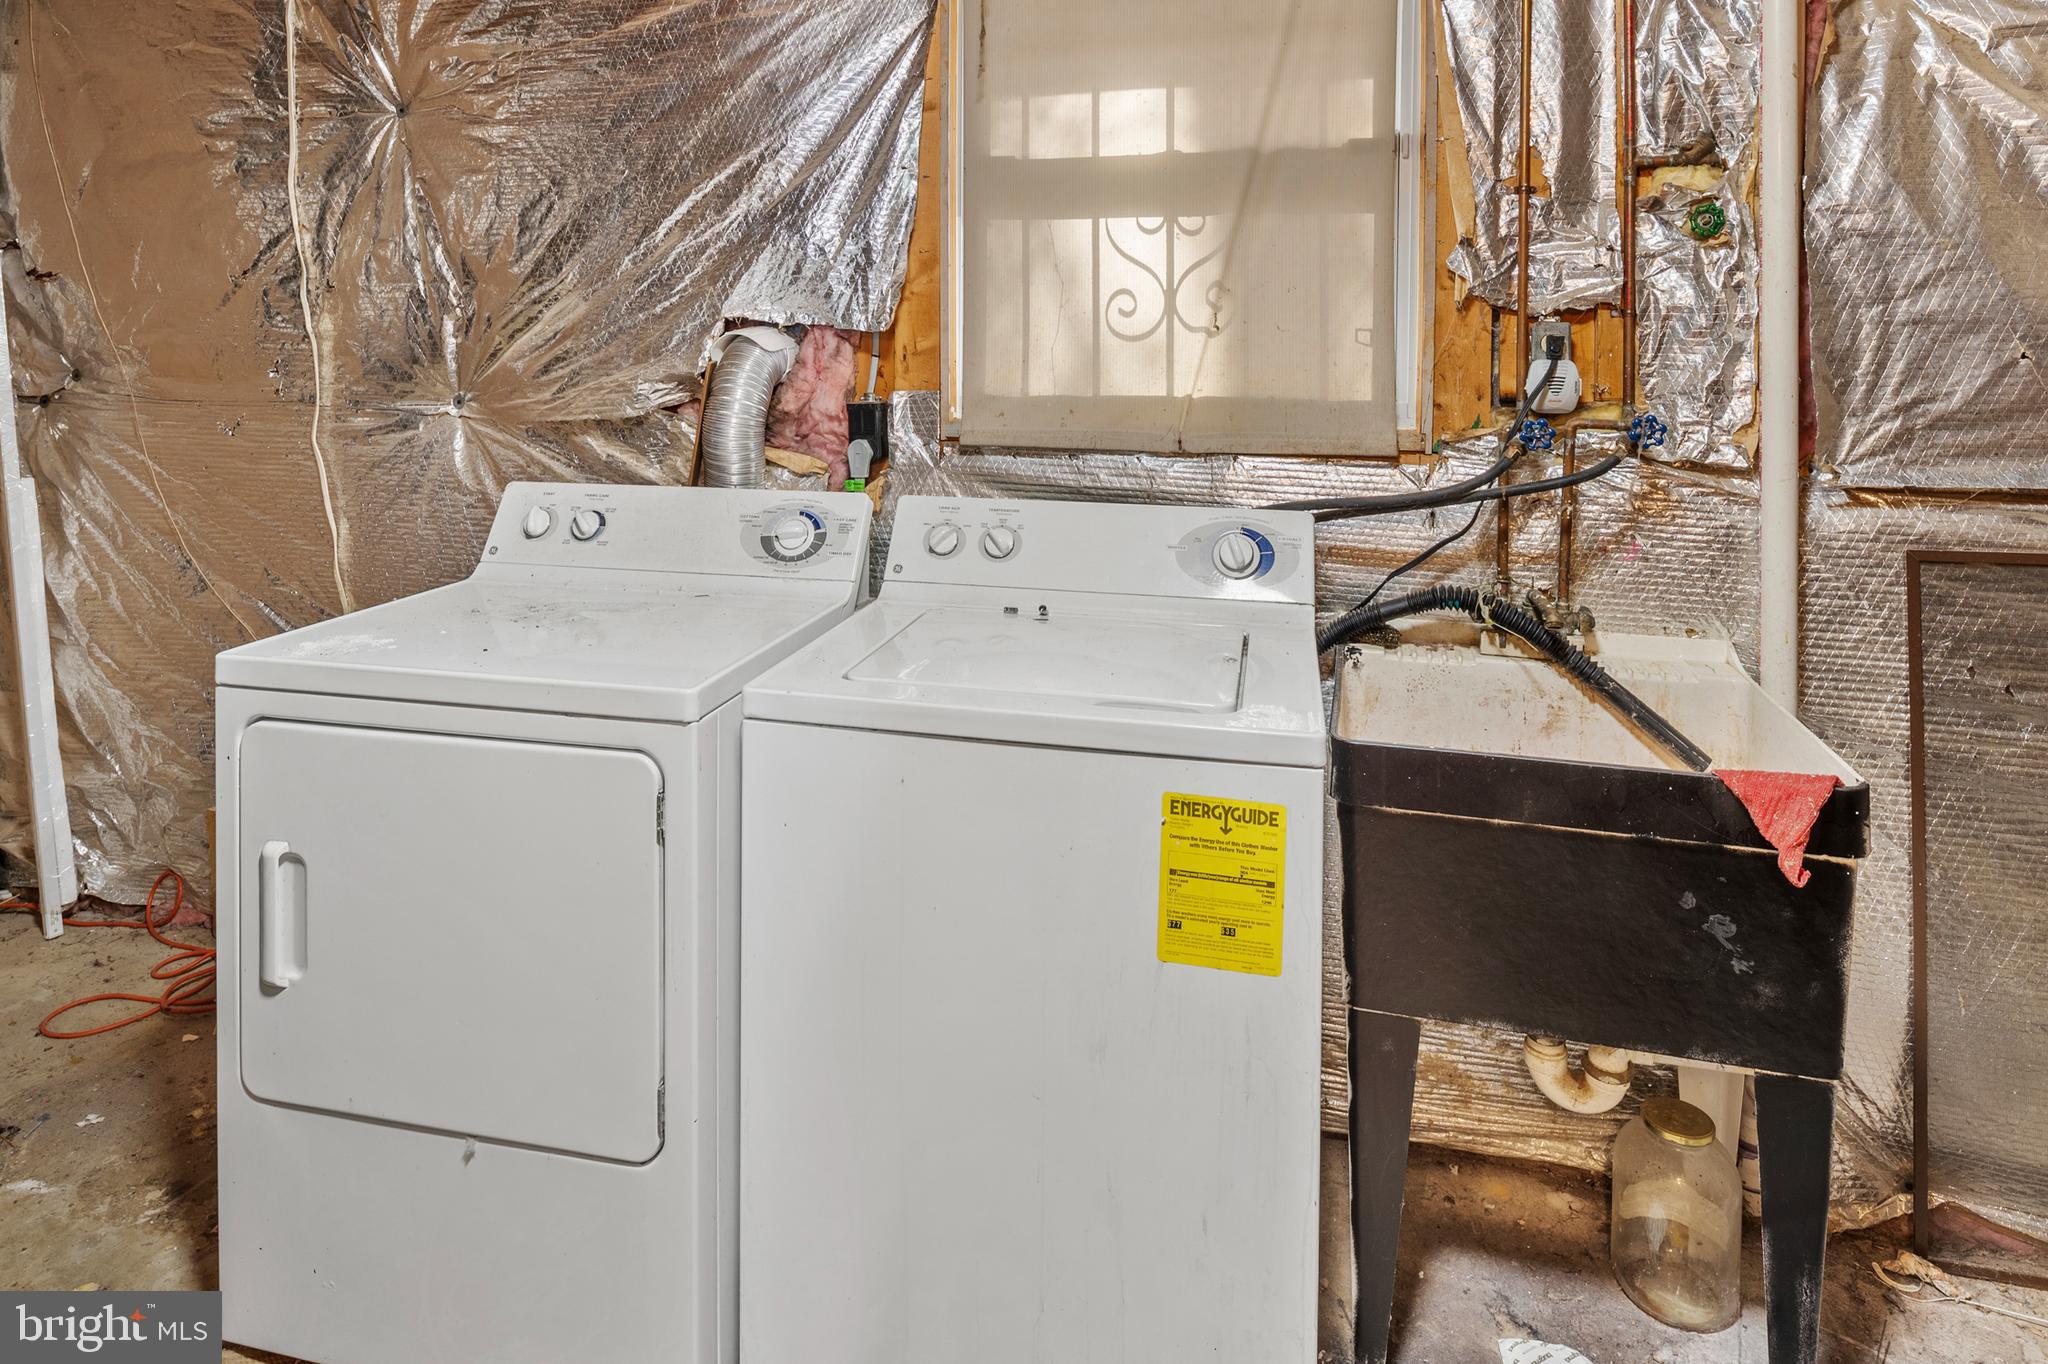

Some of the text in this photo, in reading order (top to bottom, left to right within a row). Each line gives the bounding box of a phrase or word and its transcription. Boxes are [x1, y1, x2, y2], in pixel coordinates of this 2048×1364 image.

[1169, 799, 1279, 828] ENERGYGUIDE
[1169, 833, 1190, 842] Compare
[1199, 838, 1215, 846] Energy
